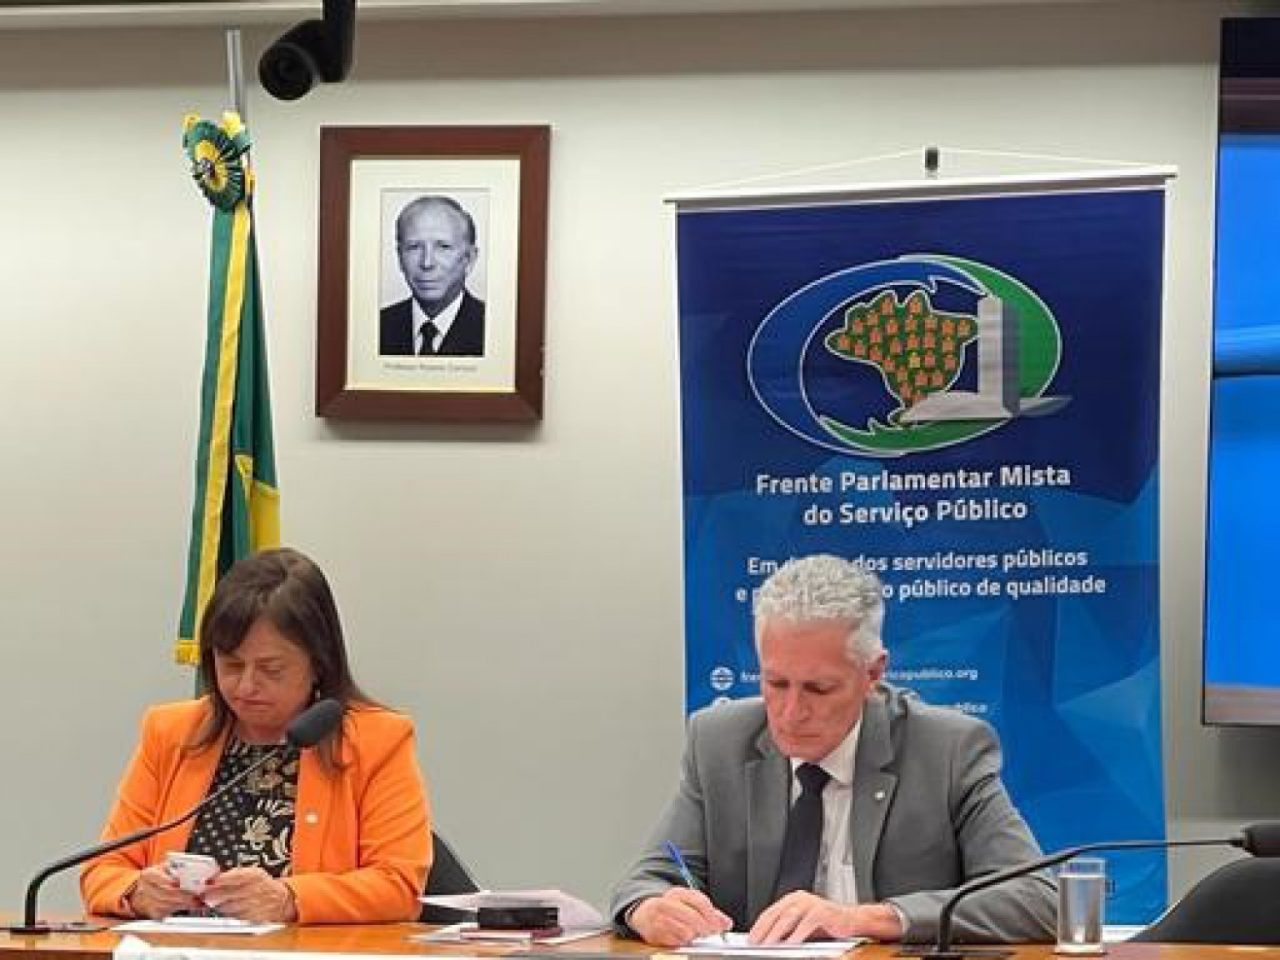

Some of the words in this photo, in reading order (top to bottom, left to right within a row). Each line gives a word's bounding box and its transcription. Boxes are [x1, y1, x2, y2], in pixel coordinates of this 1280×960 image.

[757, 474, 832, 494] Frente
[839, 469, 993, 492] Parlamentar
[999, 464, 1071, 487] Mista
[803, 504, 833, 525] do
[839, 501, 929, 528] Serviço
[936, 498, 1028, 521] Público
[747, 557, 780, 576] Em
[854, 555, 888, 571] dos
[892, 552, 998, 571] servidores
[1002, 549, 1088, 572] públicos
[736, 587, 747, 602] e
[898, 578, 971, 602] público
[977, 578, 1001, 597] de
[1005, 575, 1106, 600] qualidade
